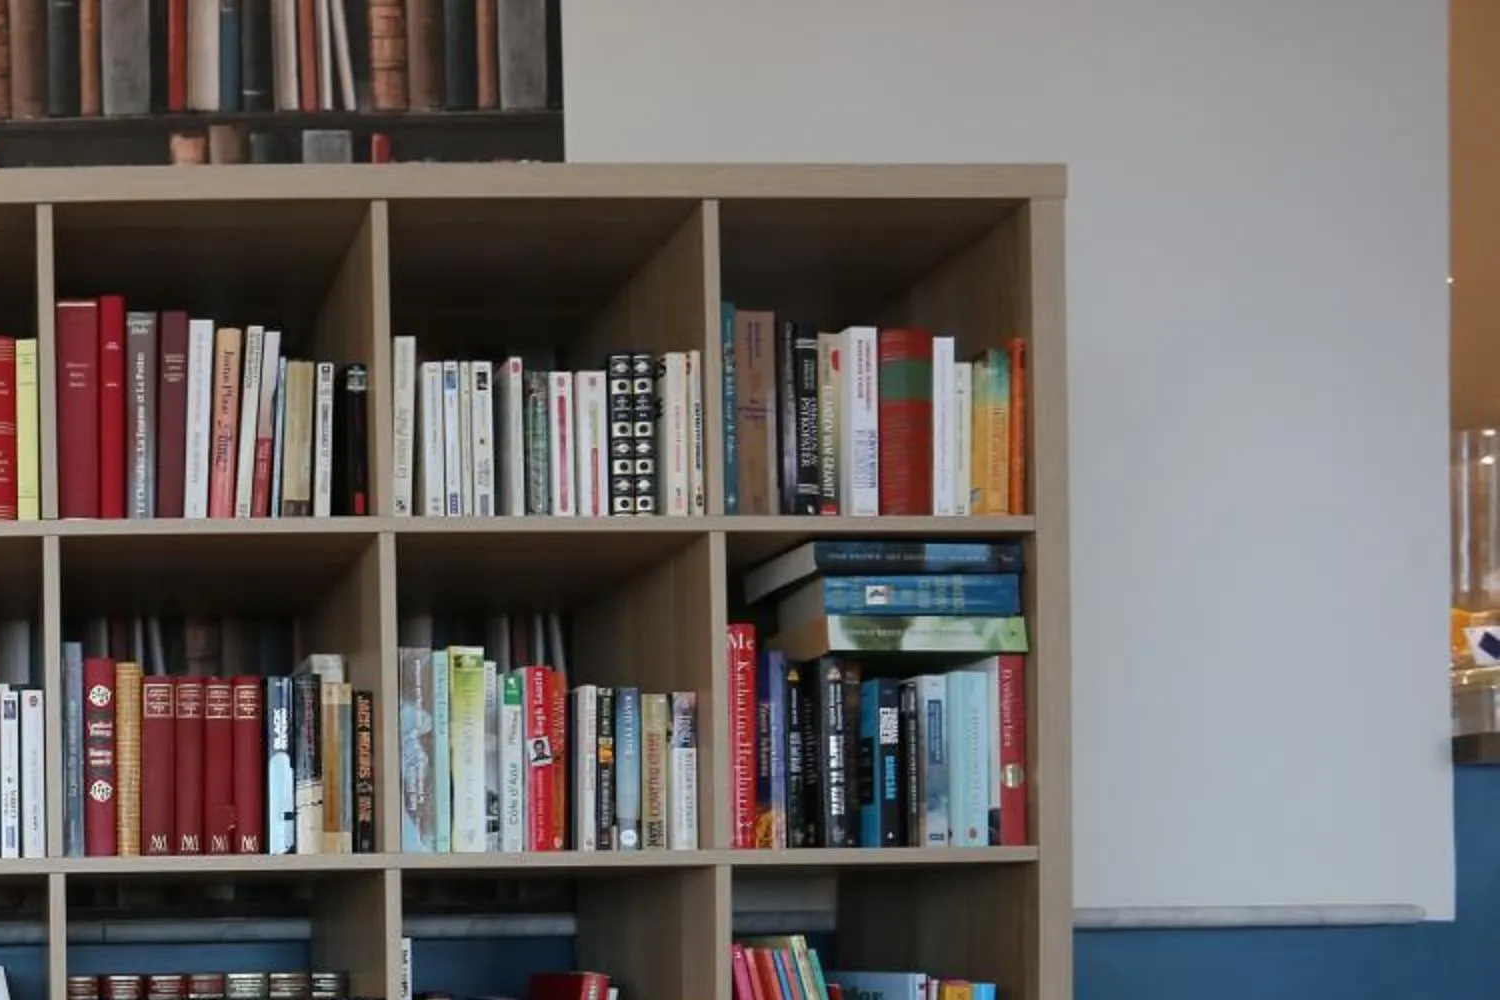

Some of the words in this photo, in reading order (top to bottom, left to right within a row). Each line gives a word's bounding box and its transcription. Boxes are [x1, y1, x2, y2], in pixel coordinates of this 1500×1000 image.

[728, 631, 756, 651] Me
[533, 670, 543, 706] Laurie
[736, 660, 752, 739] Katharine
[357, 696, 371, 729] JACK
[533, 707, 547, 735] Hugh
[508, 798, 518, 826] Côte
